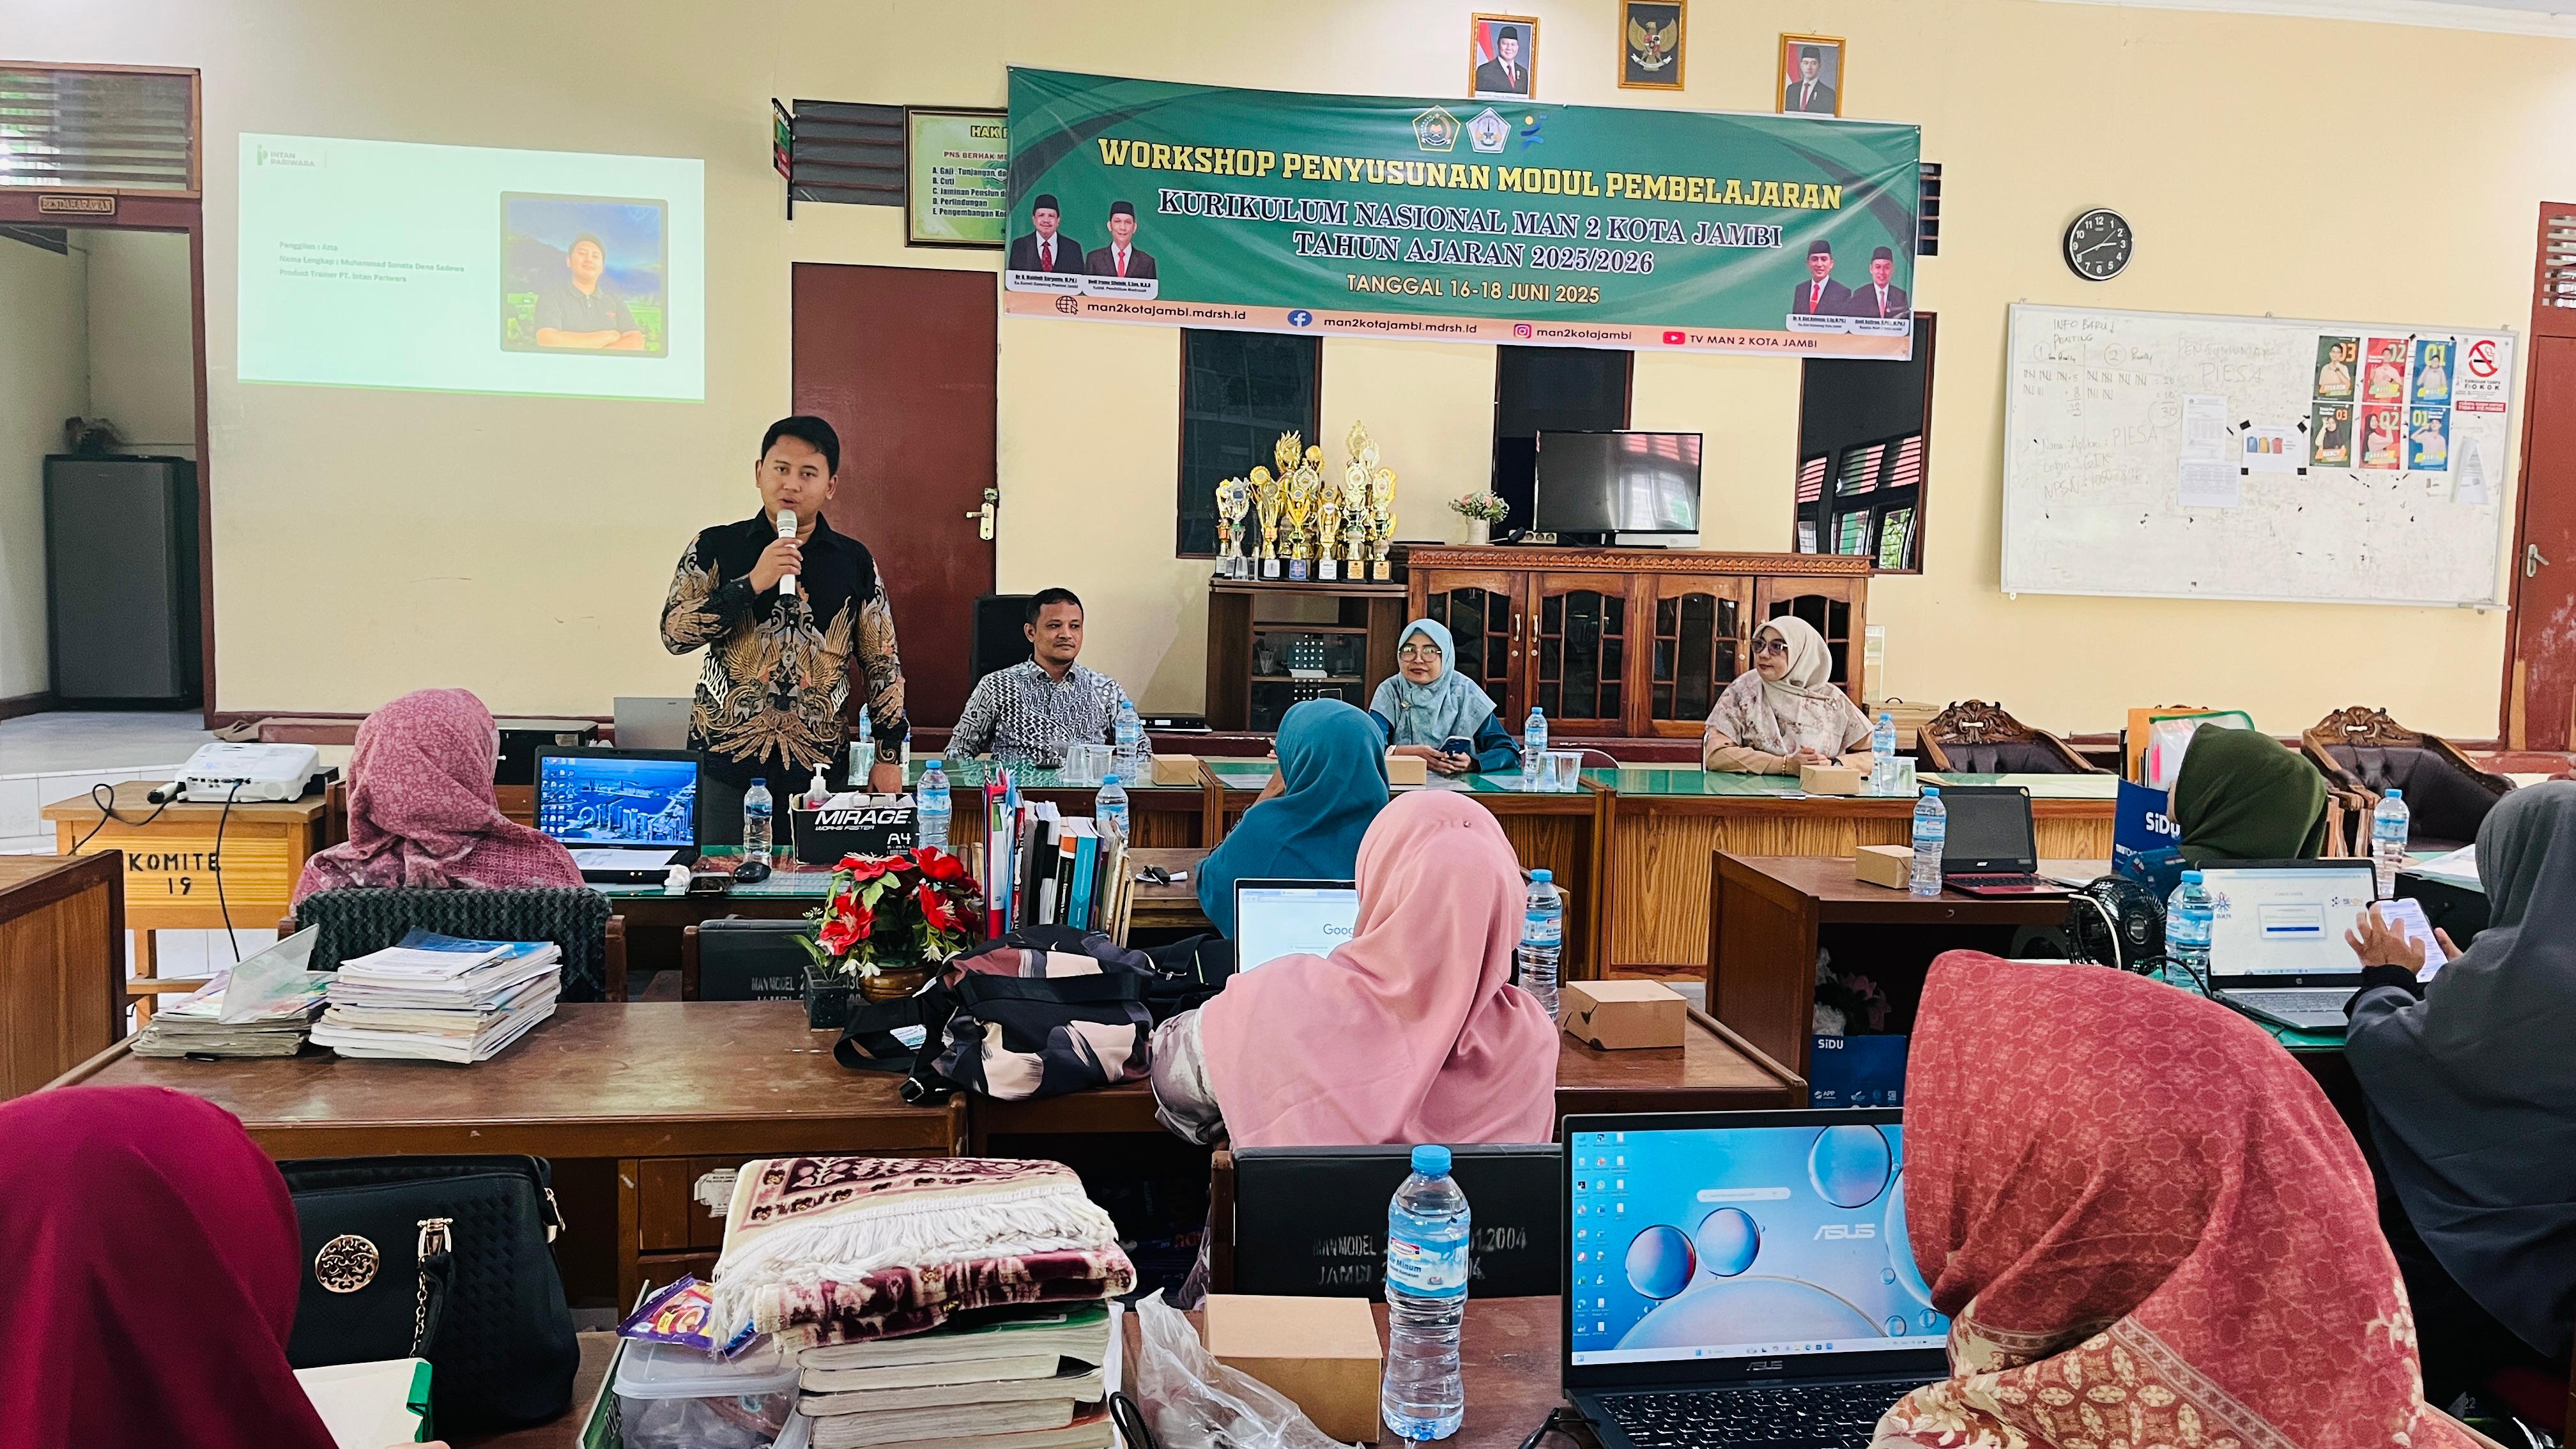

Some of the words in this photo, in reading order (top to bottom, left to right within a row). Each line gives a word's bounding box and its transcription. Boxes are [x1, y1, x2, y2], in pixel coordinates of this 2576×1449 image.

[970, 125, 1000, 139] HAK
[270, 158, 315, 167] PARIWARA
[1098, 138, 1275, 177] WORKSHOP
[1282, 153, 1491, 190] PENYUSUNAN
[1497, 165, 1600, 197] MODUL
[1606, 172, 1843, 210] PEMBELAJARAN
[42, 199, 112, 211] BENDAHARAWAN
[940, 198, 988, 207] Perlindungan
[939, 208, 993, 217] Pengembangan
[1158, 188, 1348, 226] KURIKULUM
[1354, 201, 1506, 234] NASIONAL
[1512, 210, 1578, 240] MAN
[1585, 217, 1600, 240] 2
[1607, 217, 1686, 244] KOTA
[1692, 222, 1783, 249] JAMBI
[2085, 220, 2092, 229] 11
[2095, 216, 2104, 226] 12
[2110, 220, 2114, 229] 1
[2076, 230, 2085, 239] 10
[2117, 228, 2124, 237] 2
[279, 241, 316, 251] Panggilan
[2073, 241, 2078, 251] 9
[2120, 240, 2126, 249] 3
[1293, 231, 1400, 262] TAHUN
[1405, 238, 1524, 268] AJARAN
[1531, 244, 1654, 275] 2025/2026
[2116, 252, 2122, 261] 4
[279, 255, 302, 263] Nama
[303, 256, 334, 266] Lengkap
[341, 259, 386, 268] Muhammad
[2085, 262, 2090, 271] 7
[2108, 261, 2114, 270] 5
[279, 269, 309, 277] Product
[310, 270, 337, 279] Trainer
[353, 272, 372, 281] Intan
[374, 273, 407, 282] Pariwara
[2096, 265, 2103, 274] 6
[1347, 274, 1443, 296] TANGGAL
[1450, 279, 1502, 300] 16-18
[1507, 282, 1550, 302] JUNI
[1555, 285, 1600, 304] 2025
[1087, 301, 1246, 320] man2kotajambi.mdrsh.id
[1324, 316, 1477, 334] man2kotajambi.mdrsh.id
[1537, 327, 1632, 342] man2kotajambi
[1690, 334, 1703, 344] TV
[1705, 335, 1735, 346] MAN
[1738, 337, 1745, 346] 2
[1749, 337, 1779, 347] KOTA
[1782, 338, 1818, 349] JAMBI
[2053, 319, 2078, 330] INFO
[2053, 334, 2094, 349] PENTING
[2198, 362, 2265, 385] PIESA
[2336, 409, 2349, 421] 03
[815, 809, 912, 825] MIRAGE
[887, 832, 912, 845] A4
[129, 852, 221, 872] KOMITE
[168, 877, 192, 894] 19
[1323, 923, 1353, 939] Goog
[1818, 1039, 1844, 1049] SiDU
[1813, 1223, 1876, 1241] ASUS
[1397, 1259, 1422, 1273] Minum
